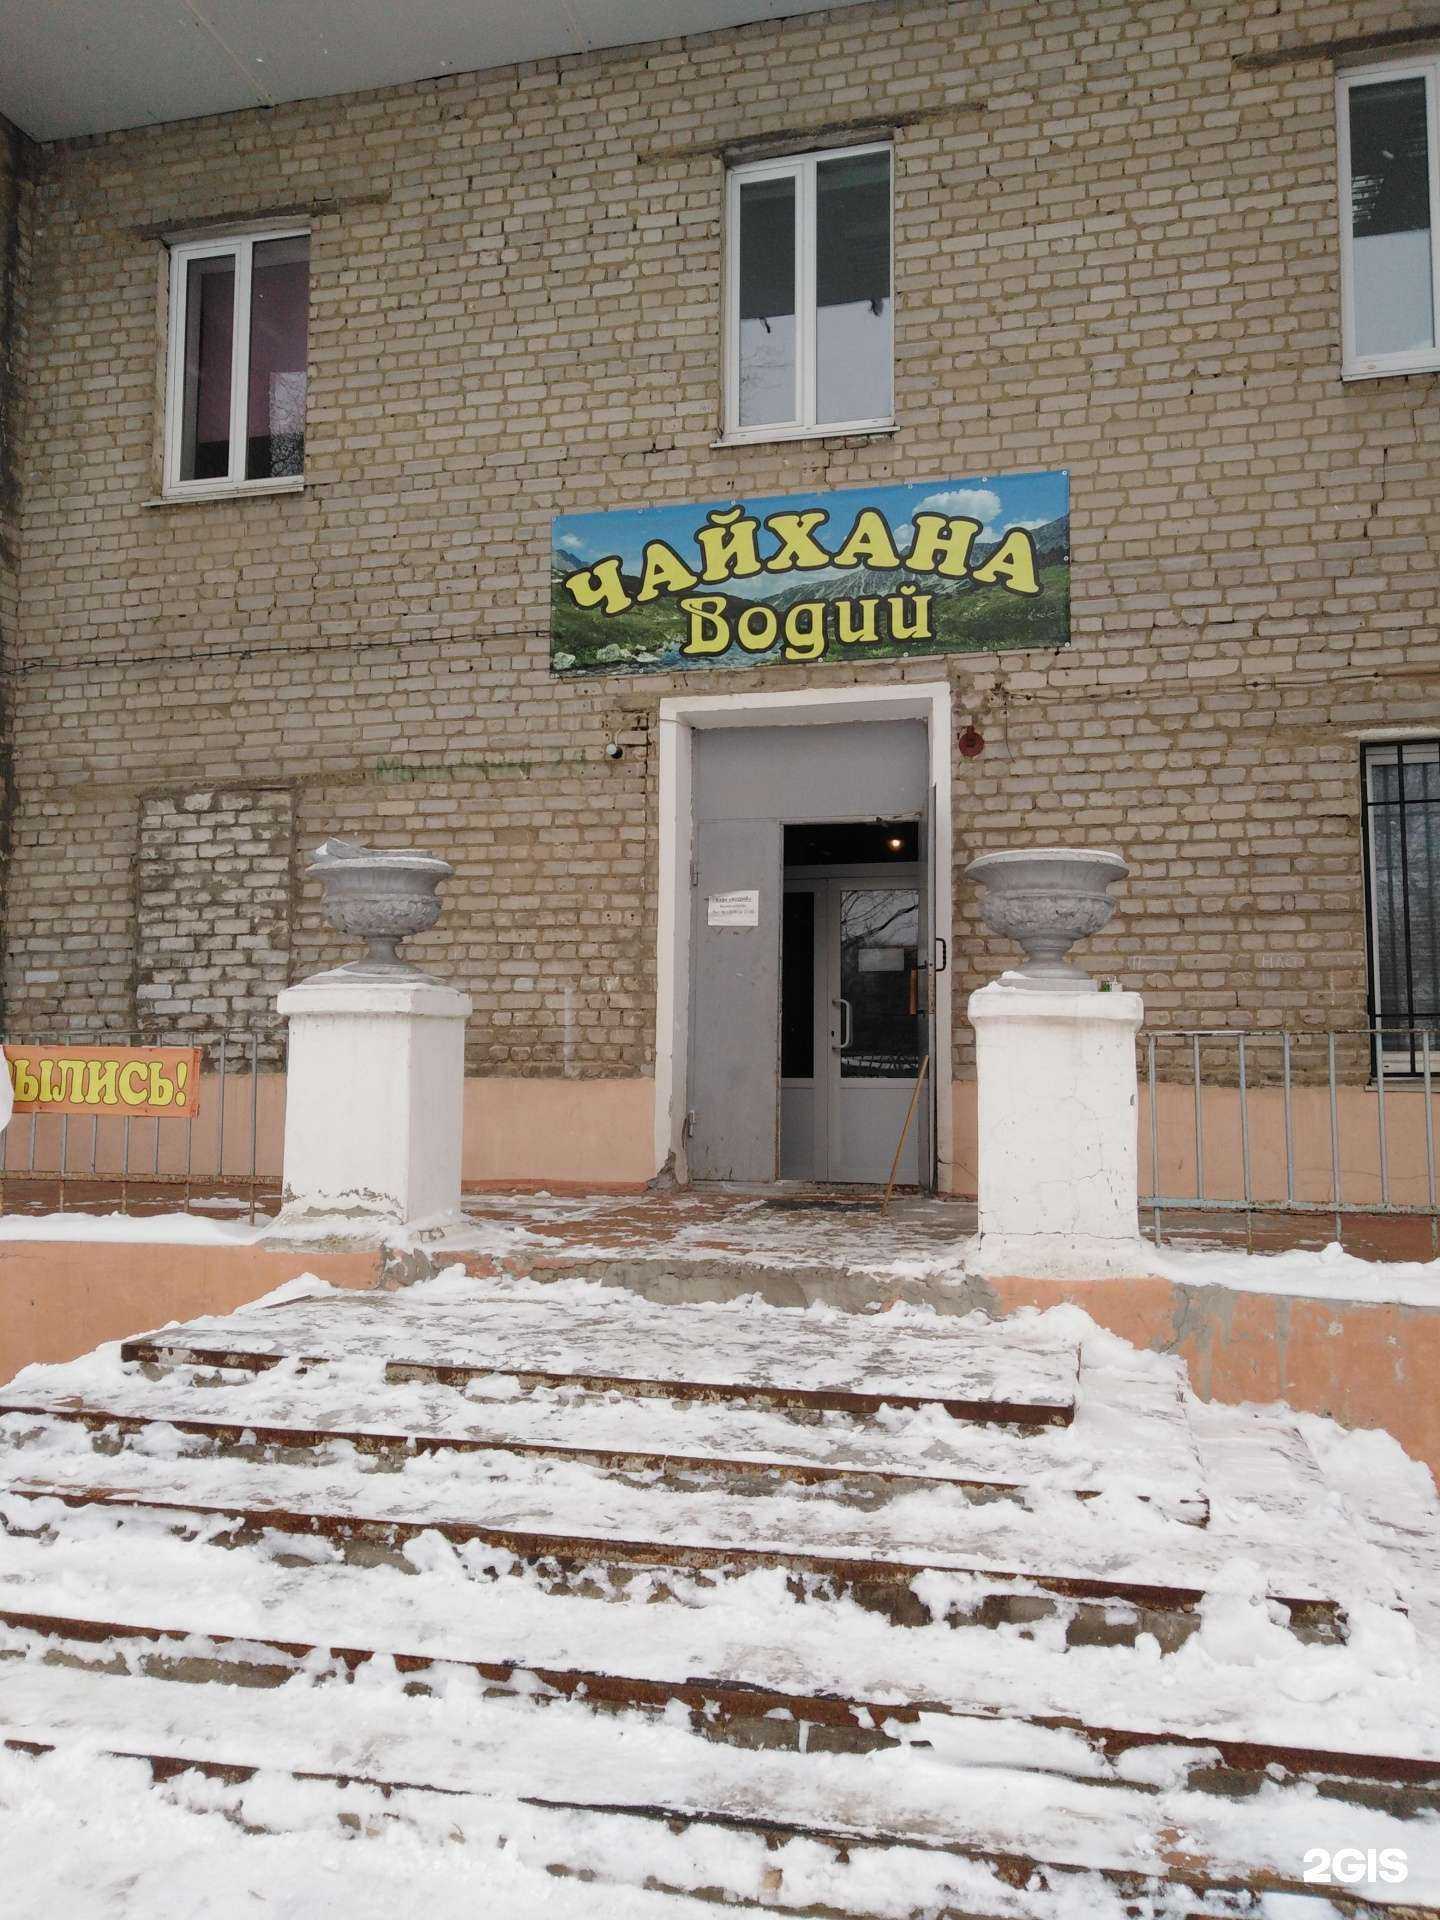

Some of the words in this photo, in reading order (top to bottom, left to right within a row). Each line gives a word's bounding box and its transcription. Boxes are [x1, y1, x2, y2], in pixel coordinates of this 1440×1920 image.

[564, 504, 1041, 616] ЧАЙХАНА
[679, 583, 934, 661] Водий
[6, 1059, 188, 1106] ЫЛИСЬ!
